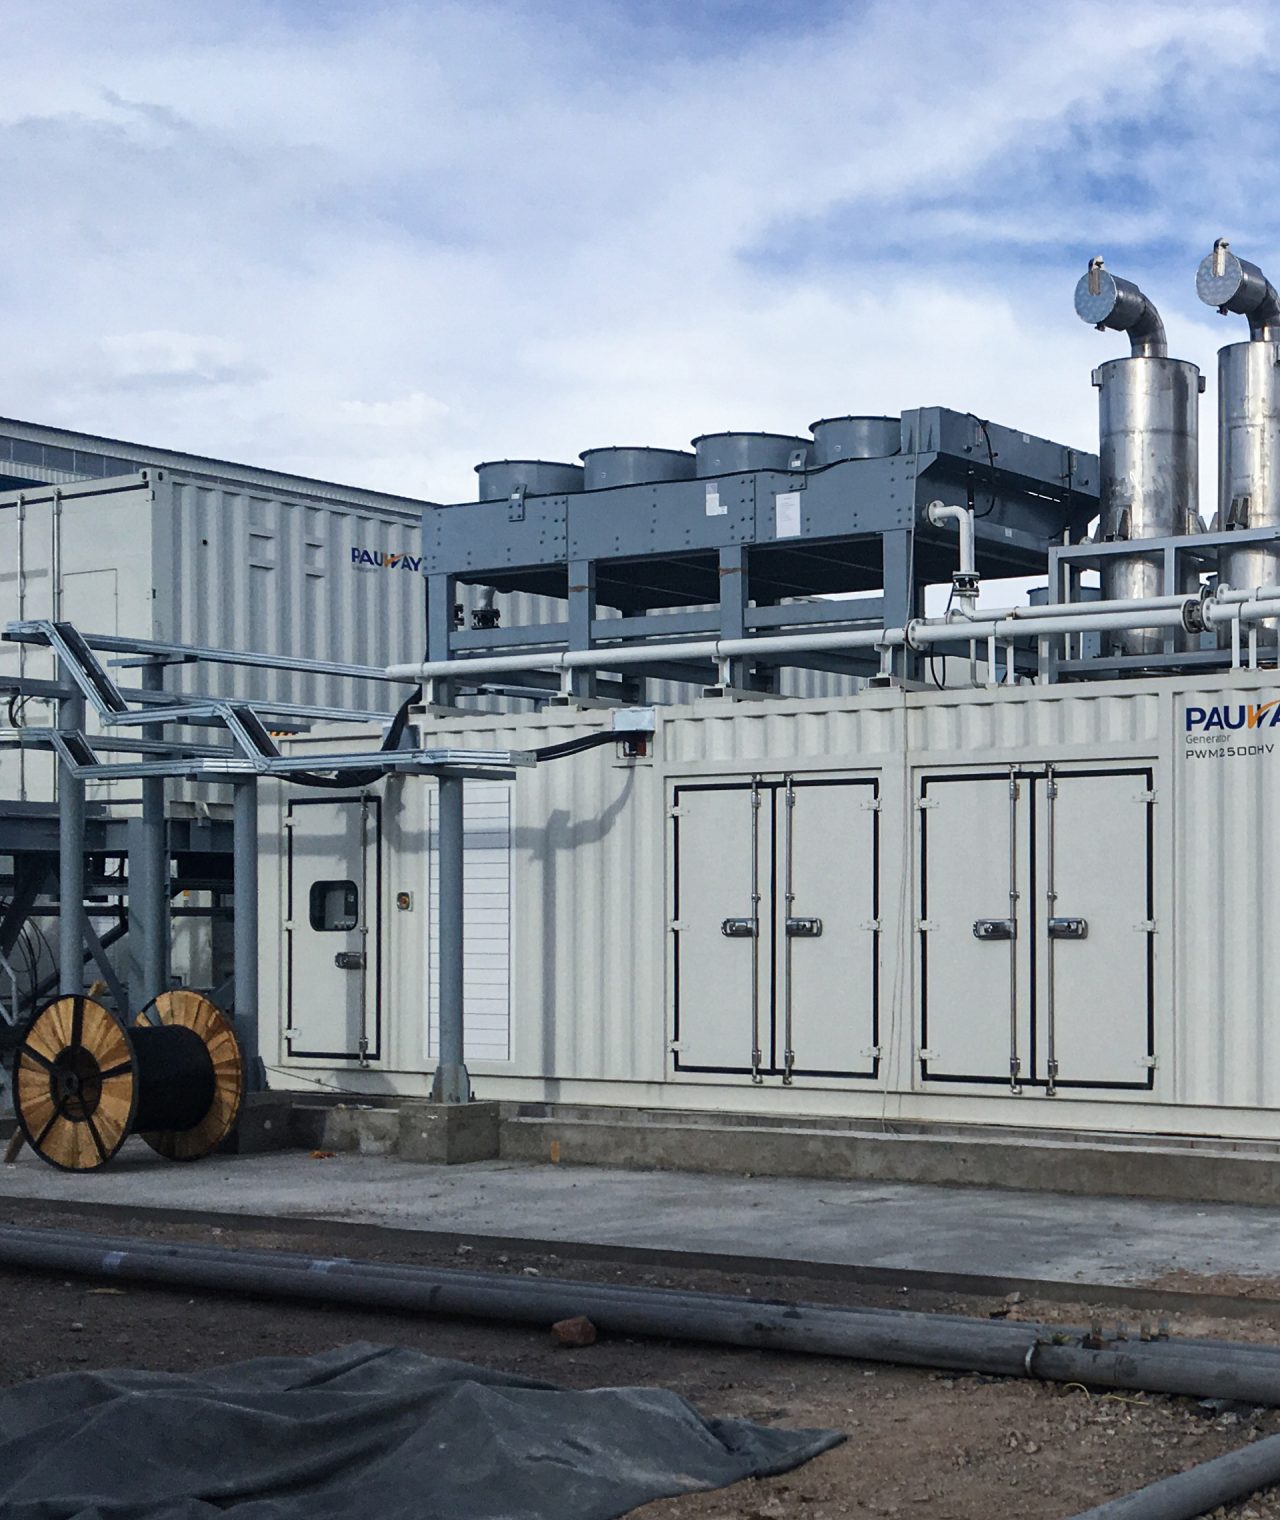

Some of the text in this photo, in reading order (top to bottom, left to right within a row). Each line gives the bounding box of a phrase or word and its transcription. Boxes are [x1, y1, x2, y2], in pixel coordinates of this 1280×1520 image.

[351, 547, 422, 571] PAUWAY
[1185, 734, 1232, 745] Generator
[1185, 744, 1275, 760] PWM2500HV
